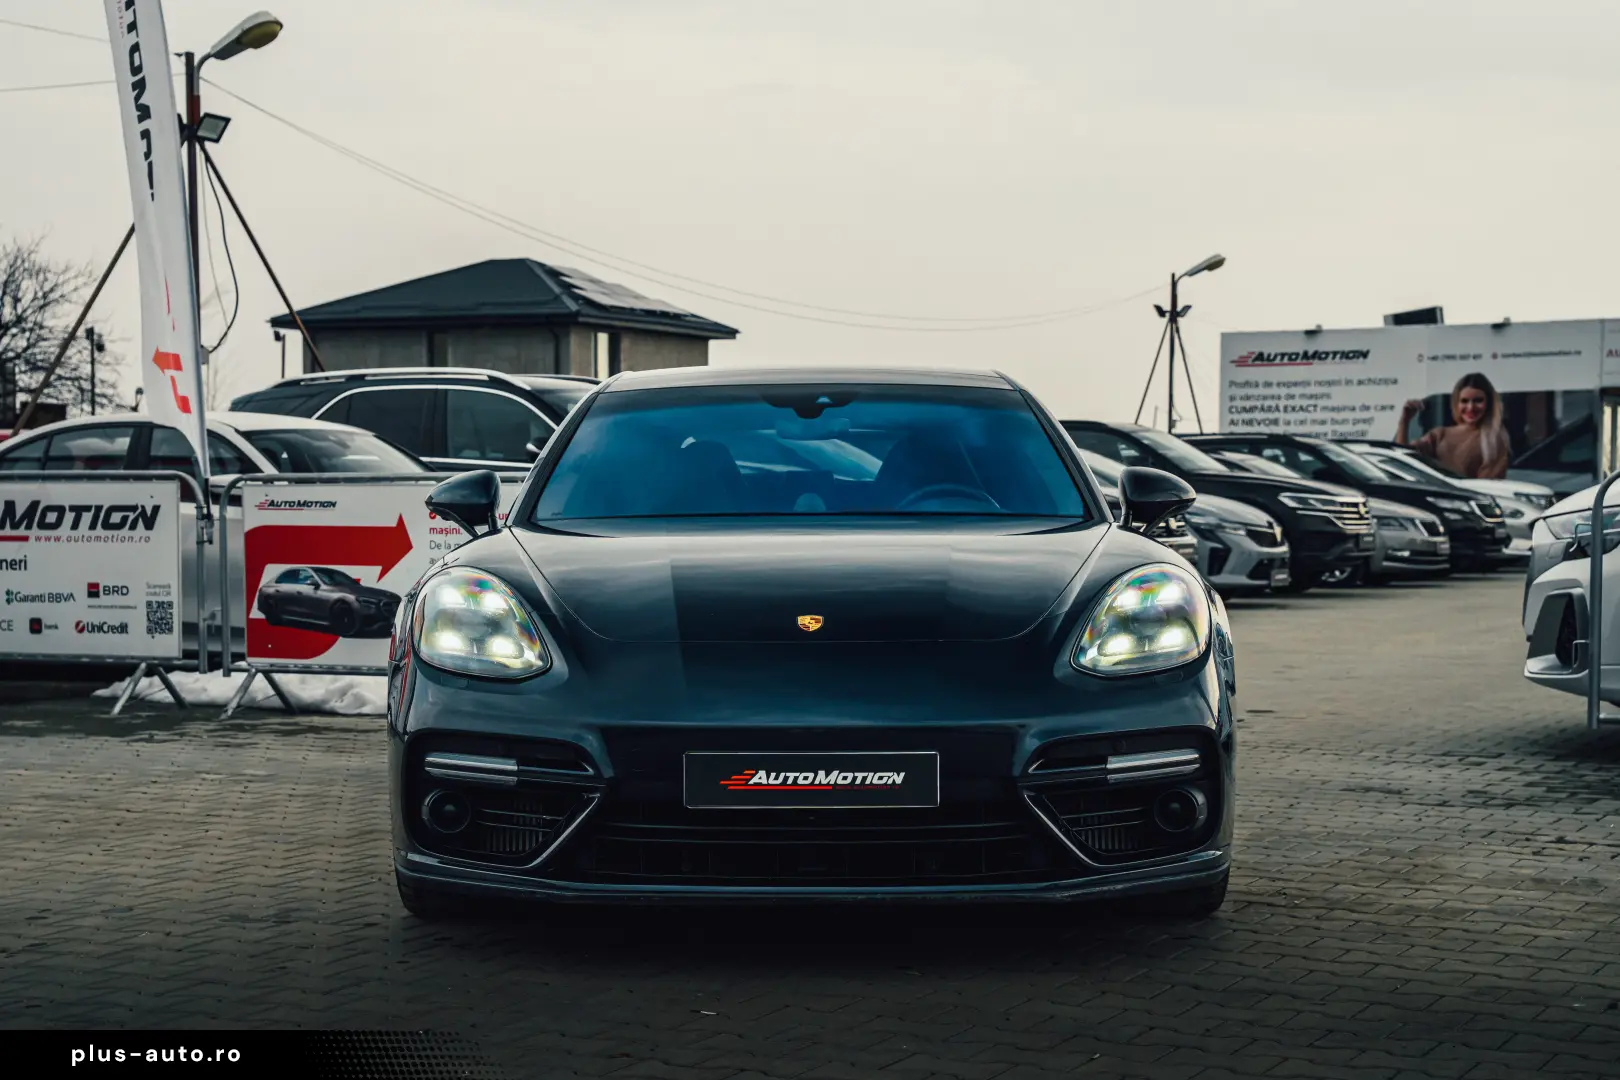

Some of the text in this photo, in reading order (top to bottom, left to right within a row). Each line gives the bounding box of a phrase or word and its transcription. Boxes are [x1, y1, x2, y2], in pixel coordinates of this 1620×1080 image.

[1283, 402, 1319, 414] EXACT
[34, 534, 151, 543] www.automotion.ro
[429, 540, 442, 550] De
[444, 540, 452, 550] la
[15, 590, 76, 603] Garanti BBVA
[102, 585, 130, 597] BRD
[86, 621, 129, 634] UniCredit
